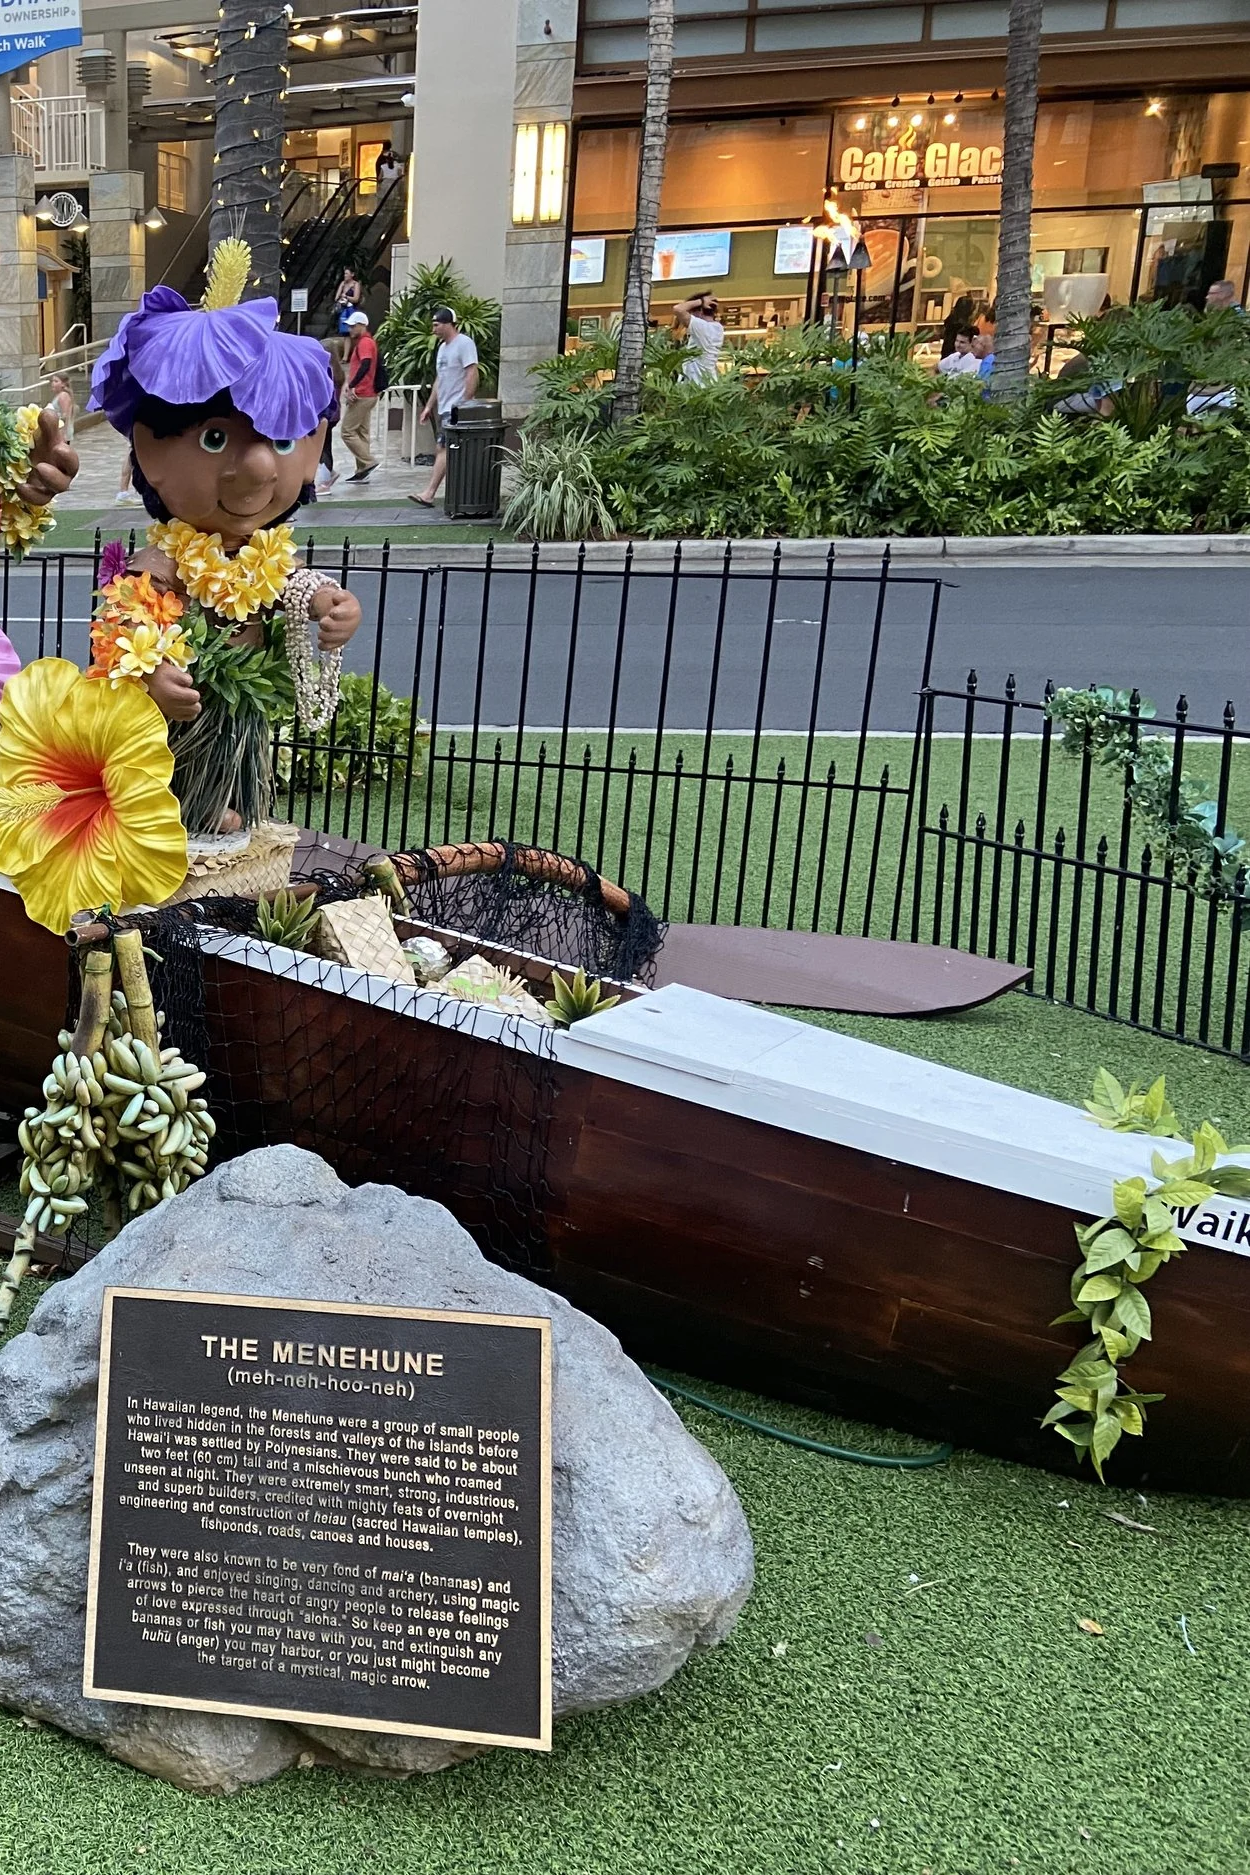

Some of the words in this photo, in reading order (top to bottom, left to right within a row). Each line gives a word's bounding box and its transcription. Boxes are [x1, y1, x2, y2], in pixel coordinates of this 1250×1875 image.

[3, 7, 70, 23] OWNERSHIP
[844, 180, 877, 191] Coffee
[885, 178, 921, 189] Crepes
[928, 177, 961, 188] Gelato
[971, 175, 1004, 185] Pastri
[924, 142, 1004, 179] Glac
[200, 1334, 258, 1361] THE
[272, 1340, 443, 1376] MENEHUNE
[227, 1366, 415, 1400] (meh-neh-hoo-neh)
[126, 1395, 138, 1409] In
[142, 1397, 196, 1414] Hawaiian
[200, 1402, 243, 1419] legend,
[248, 1405, 267, 1420] the
[271, 1408, 333, 1425] Menehune
[337, 1416, 367, 1429] were
[371, 1419, 380, 1430] a
[383, 1420, 419, 1435] group
[422, 1421, 436, 1435] of
[439, 1424, 473, 1438] small
[477, 1428, 520, 1443] people
[126, 1412, 151, 1426] who
[154, 1414, 183, 1429] lived
[186, 1416, 226, 1432] hidden
[230, 1420, 242, 1434] in
[246, 1422, 265, 1436] the
[269, 1424, 311, 1440] forests
[314, 1429, 338, 1443] and
[341, 1431, 385, 1448] valleys
[388, 1434, 402, 1448] of
[405, 1436, 425, 1451] the
[429, 1438, 474, 1455] islands
[478, 1442, 519, 1459] before
[140, 1445, 161, 1459] two
[165, 1447, 189, 1462] feet
[192, 1449, 212, 1465] (60
[216, 1453, 238, 1469] cm)
[265, 1457, 288, 1470] and
[292, 1461, 300, 1472] a
[304, 1460, 379, 1479] mischievous
[383, 1467, 421, 1483] bunch
[424, 1471, 451, 1486] who
[454, 1476, 502, 1491] roamed
[173, 1434, 197, 1447] was
[201, 1436, 242, 1450] settled
[246, 1437, 261, 1455] by
[264, 1439, 341, 1459] Polynesians.
[346, 1446, 376, 1465] They
[379, 1452, 410, 1465] were
[413, 1454, 440, 1469] said
[443, 1456, 457, 1470] to
[461, 1457, 478, 1472] be
[481, 1460, 518, 1476] about
[123, 1462, 166, 1476] unseen
[170, 1464, 182, 1478] at
[186, 1466, 219, 1482] night.
[225, 1469, 254, 1486] They
[291, 1476, 350, 1495] extremely
[354, 1483, 393, 1499] smart,
[397, 1486, 441, 1504] strong,
[445, 1489, 519, 1511] industrious,
[137, 1478, 160, 1492] and
[163, 1482, 204, 1496] superb
[347, 1497, 388, 1515] mighty
[392, 1500, 423, 1517] feats
[427, 1504, 441, 1519] of
[443, 1509, 503, 1525] overnight
[119, 1494, 188, 1513] engineering
[192, 1500, 215, 1513] and
[218, 1503, 292, 1520] construction
[296, 1509, 309, 1522] of
[313, 1510, 347, 1526] heiau
[351, 1514, 397, 1531] (sacred
[402, 1518, 459, 1537] Hawaiian
[463, 1525, 522, 1545] temples),
[200, 1516, 262, 1536] fishponds,
[266, 1524, 305, 1540] roads,
[309, 1529, 354, 1543] canoes
[357, 1532, 381, 1546] and
[385, 1533, 434, 1552] houses.
[127, 1541, 157, 1560] They
[160, 1547, 189, 1560] were
[193, 1548, 219, 1563] also
[223, 1551, 261, 1567] known
[265, 1555, 278, 1569] to
[282, 1556, 297, 1571] be
[301, 1561, 328, 1577] very
[332, 1561, 360, 1577] fond
[364, 1565, 378, 1579] of
[419, 1571, 483, 1592] (bananas)
[486, 1580, 511, 1593] and
[137, 1559, 171, 1578] (fish),
[176, 1565, 199, 1578] and
[360, 1583, 383, 1597] and
[387, 1587, 438, 1605] archery,
[442, 1592, 477, 1609] using
[481, 1597, 520, 1612] magic
[126, 1577, 167, 1591] arrows
[170, 1579, 183, 1593] to
[187, 1582, 224, 1597] pierce
[288, 1592, 301, 1605] of
[305, 1596, 340, 1612] angry
[344, 1600, 386, 1616] people
[390, 1602, 403, 1617] to
[407, 1605, 454, 1622] release
[458, 1609, 509, 1629] feelings
[135, 1593, 148, 1606] of
[151, 1594, 177, 1609] love
[350, 1615, 368, 1630] So
[372, 1617, 403, 1636] keep
[406, 1624, 423, 1636] an
[427, 1626, 450, 1640] eye
[454, 1629, 471, 1642] on
[474, 1631, 499, 1646] any
[131, 1609, 182, 1627] bananas
[186, 1617, 200, 1629] or
[203, 1616, 226, 1631] fish
[230, 1622, 252, 1635] you
[256, 1624, 282, 1640] may
[286, 1625, 316, 1641] have
[320, 1630, 345, 1645] with
[349, 1635, 376, 1650] you,
[381, 1637, 404, 1651] and
[409, 1641, 474, 1659] extinguish
[478, 1649, 502, 1664] any
[175, 1631, 220, 1651] (anger)
[223, 1638, 246, 1652] you
[250, 1641, 276, 1657] may
[280, 1642, 324, 1661] harbor,
[328, 1650, 343, 1661] or
[345, 1651, 369, 1666] you
[373, 1652, 397, 1668] just
[400, 1656, 436, 1673] might
[440, 1660, 490, 1678] become
[197, 1650, 216, 1665] the
[220, 1653, 257, 1671] target
[260, 1657, 273, 1671] of
[277, 1661, 285, 1673] a
[349, 1669, 387, 1686] magic
[391, 1674, 430, 1690] arrow.
